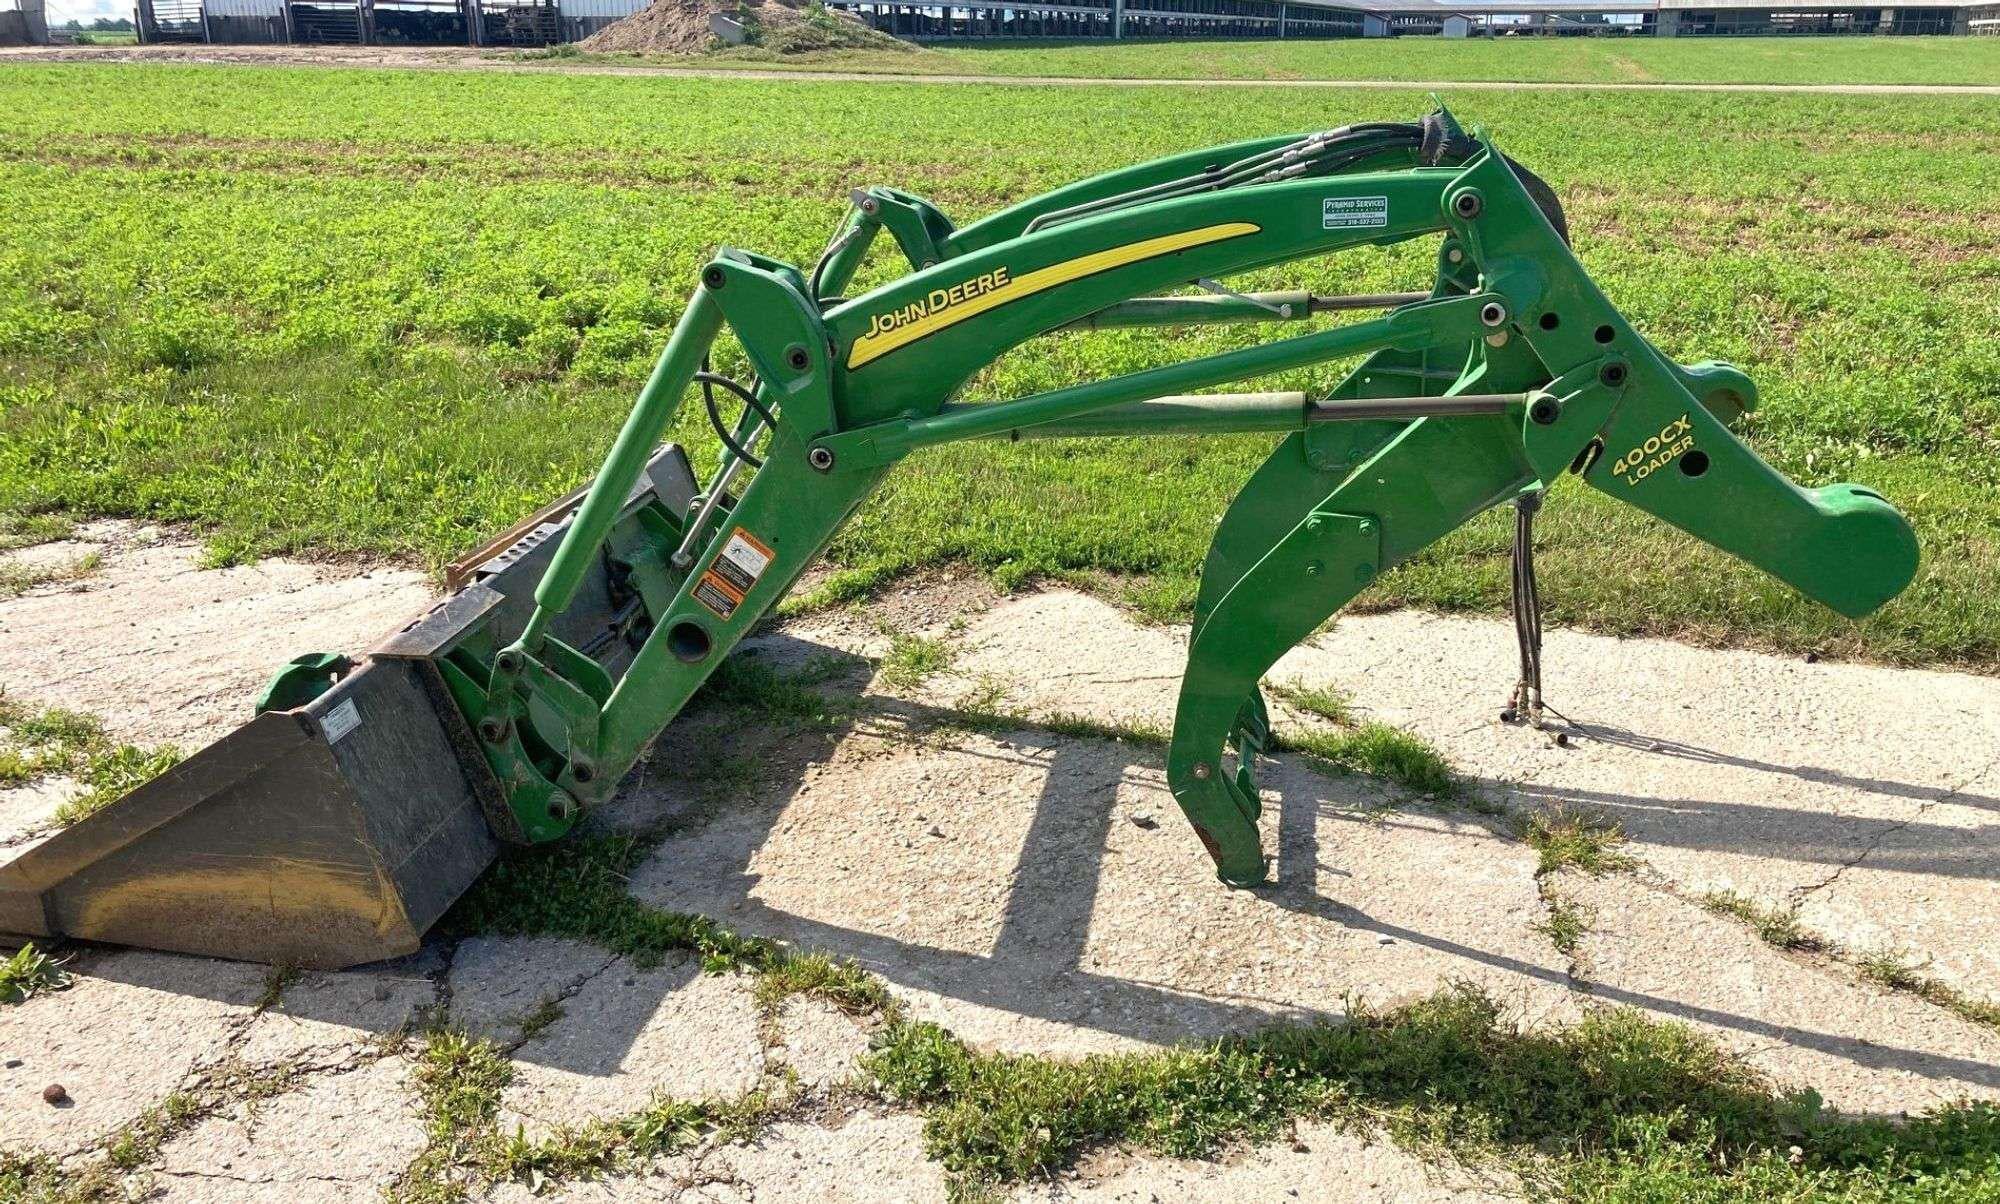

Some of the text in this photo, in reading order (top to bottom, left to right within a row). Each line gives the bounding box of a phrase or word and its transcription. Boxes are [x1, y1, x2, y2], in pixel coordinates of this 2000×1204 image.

[1326, 199, 1385, 209] PYRAMID SERVICES
[865, 266, 1010, 339] JOHN DEERE
[1612, 413, 1693, 476] 400CX
[1627, 435, 1695, 486] LOADER
